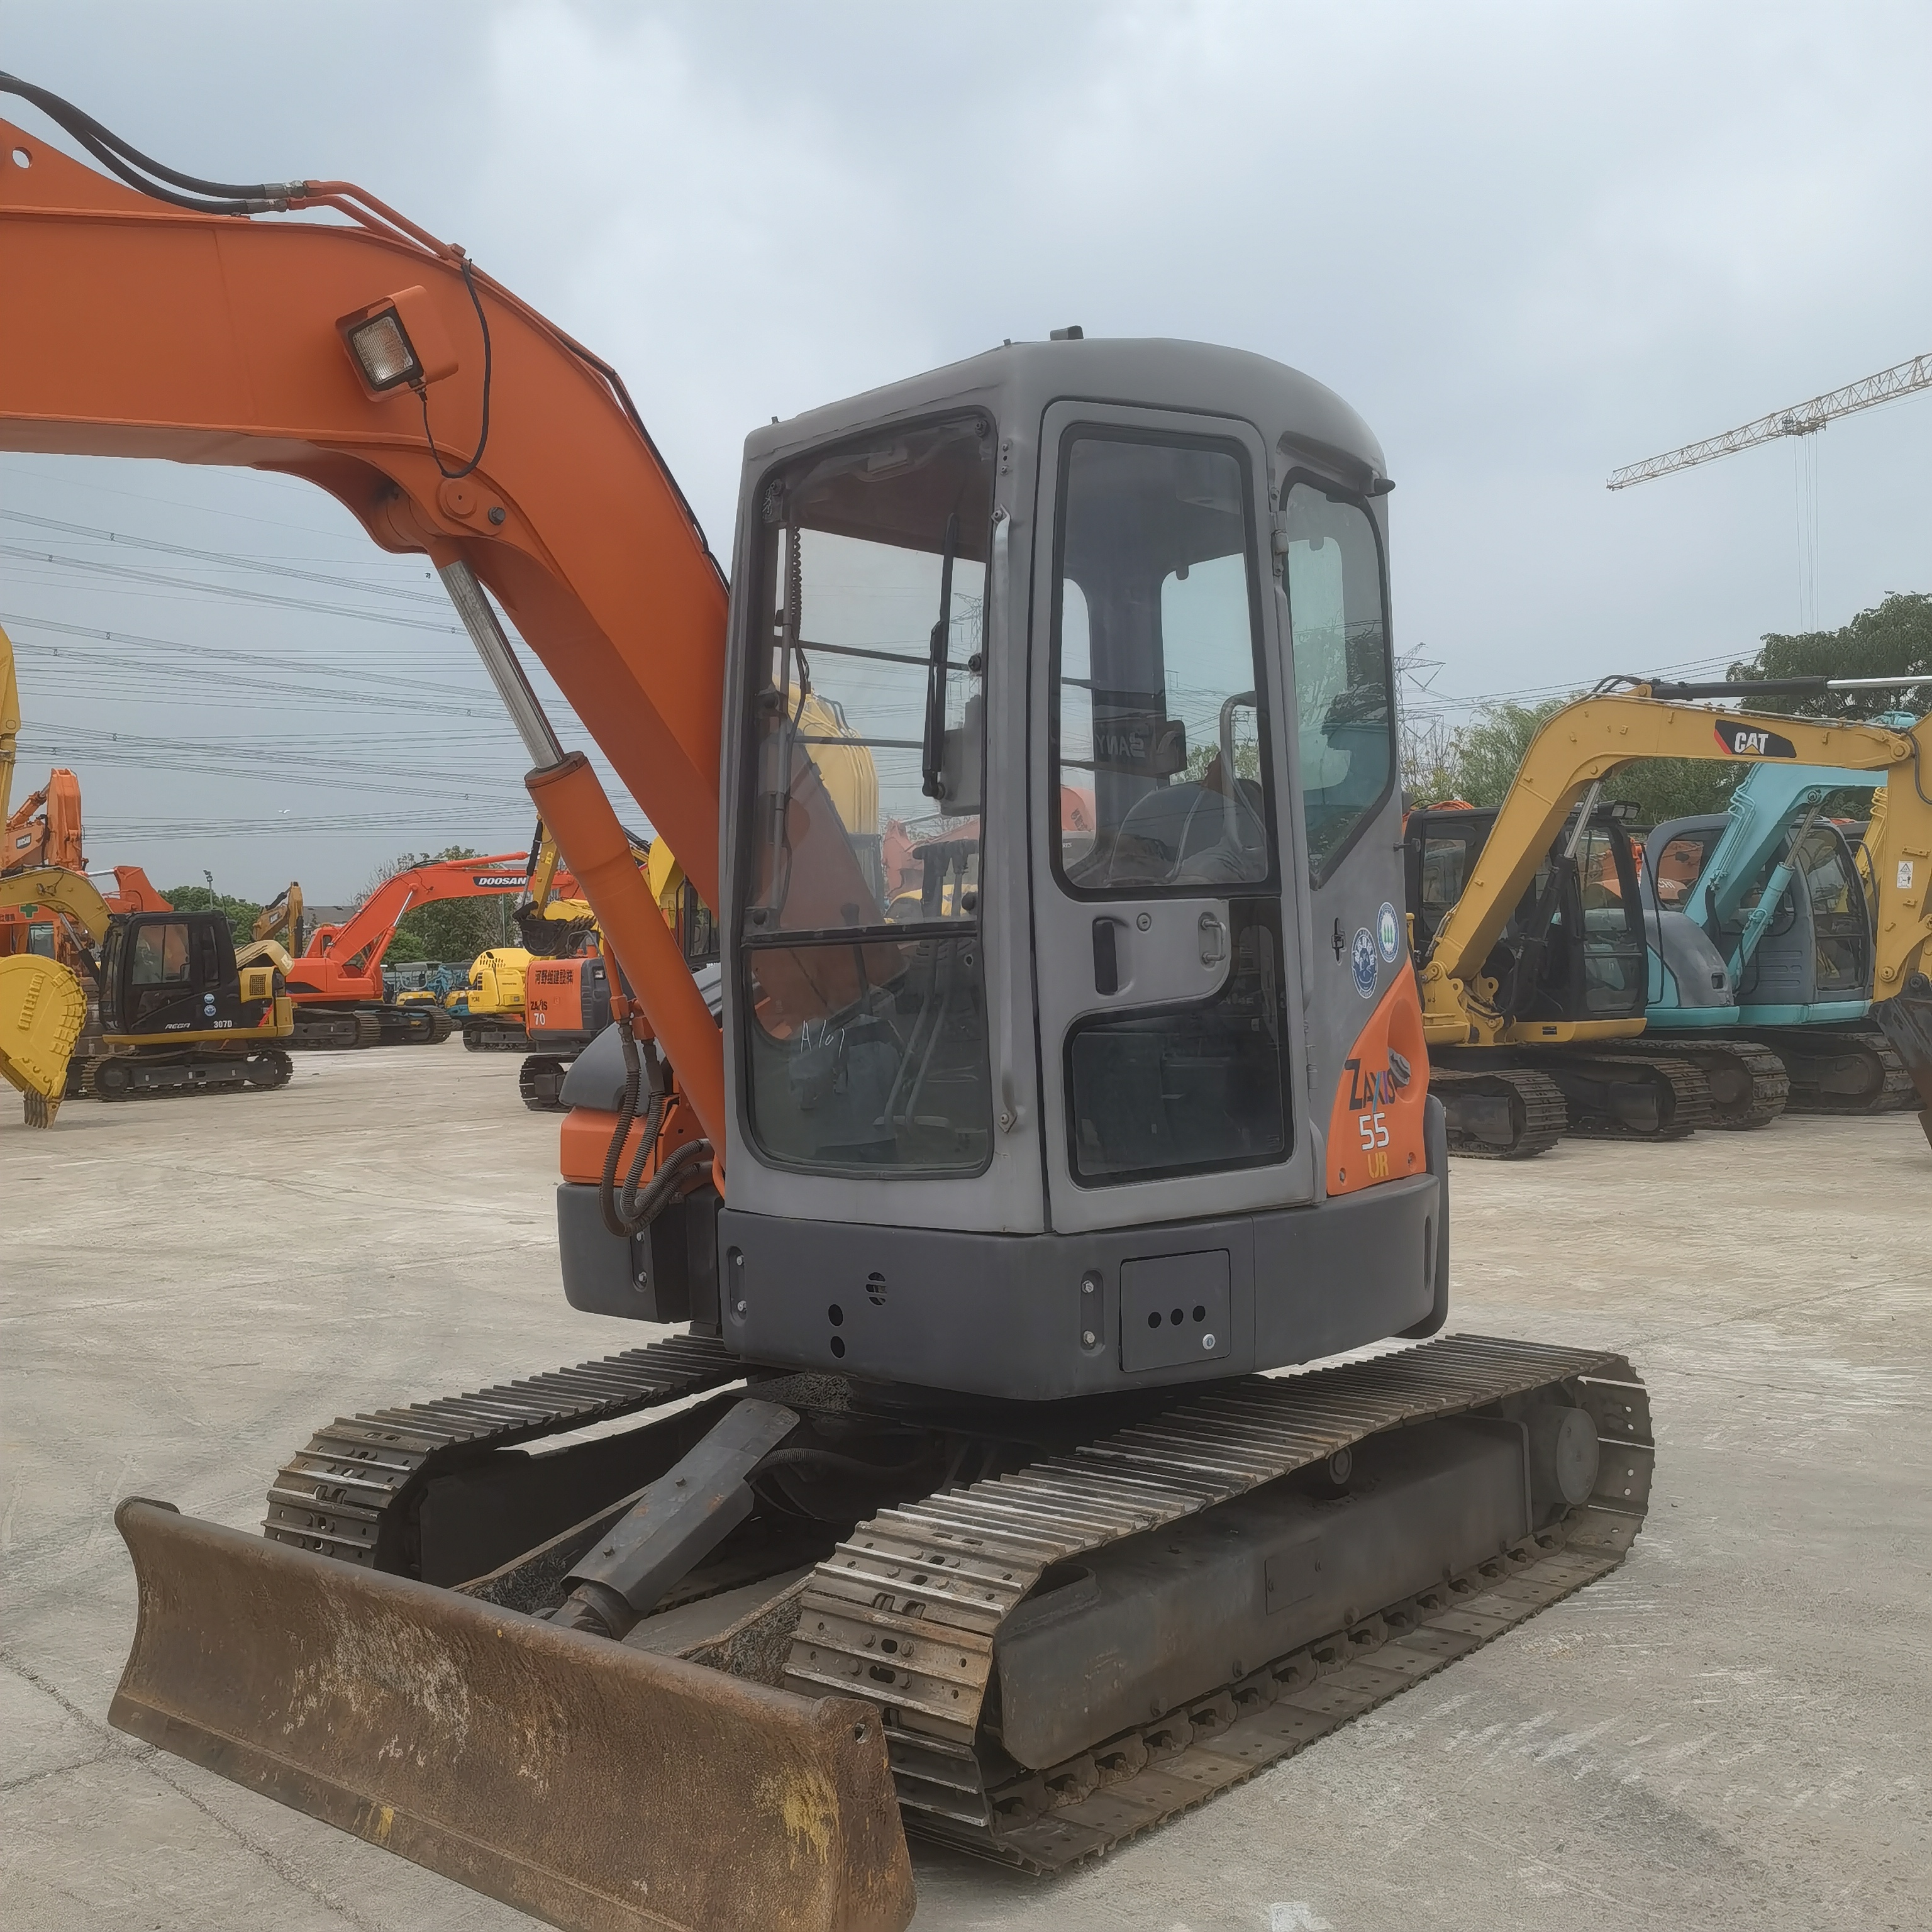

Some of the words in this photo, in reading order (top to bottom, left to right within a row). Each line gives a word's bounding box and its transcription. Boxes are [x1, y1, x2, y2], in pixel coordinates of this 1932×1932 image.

[1735, 732, 1769, 755] CAT
[478, 877, 527, 886] DOOSAN
[533, 1013, 545, 1026] 70
[1344, 1058, 1396, 1113] ZAXIS
[1358, 1112, 1389, 1151] 55
[1367, 1151, 1389, 1179] UR
